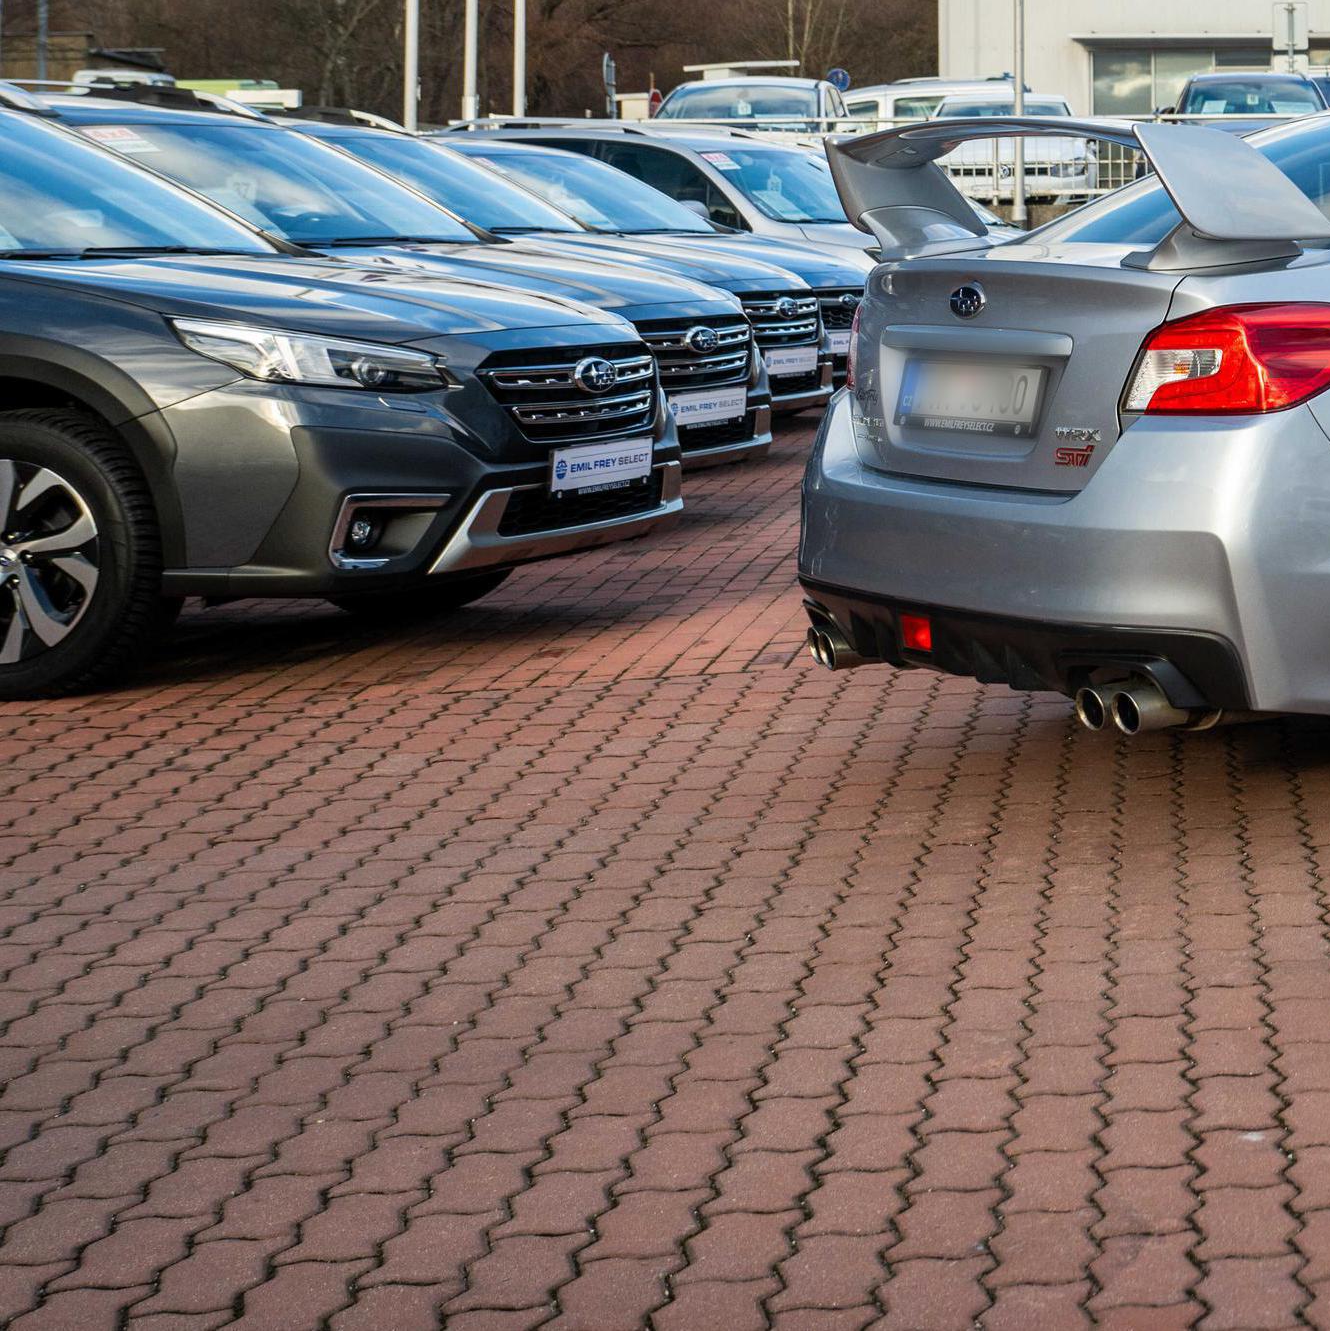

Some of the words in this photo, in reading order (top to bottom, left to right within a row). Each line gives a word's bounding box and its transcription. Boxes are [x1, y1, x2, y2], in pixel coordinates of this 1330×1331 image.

[680, 404, 699, 414] EMIL
[699, 402, 718, 411] FREY
[718, 398, 744, 408] SELECT
[923, 418, 995, 433] WWW.EMILFREYSELECT.CZ
[570, 460, 592, 473] EMIL
[593, 457, 617, 471] FREY
[618, 453, 649, 467] SELECT
